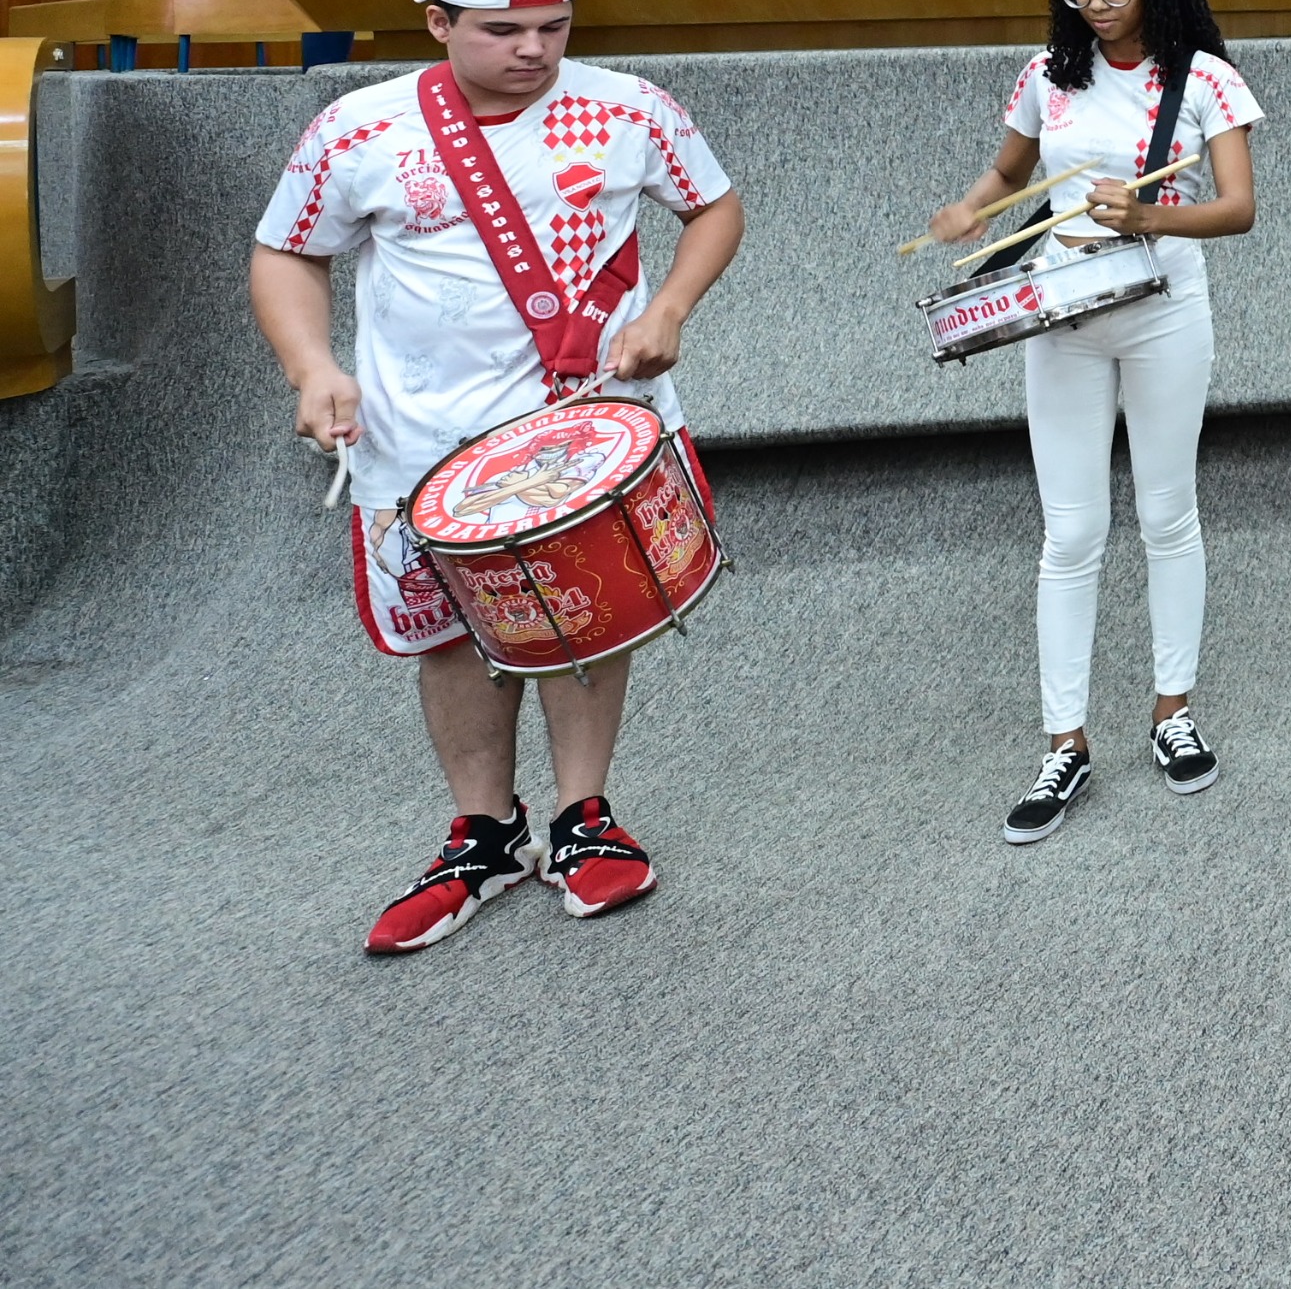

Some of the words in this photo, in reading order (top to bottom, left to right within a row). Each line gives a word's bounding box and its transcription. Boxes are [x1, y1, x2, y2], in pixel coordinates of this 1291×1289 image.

[404, 209, 470, 234] squadrão
[416, 460, 470, 517] torcida
[437, 510, 567, 540] BATERIA
[555, 844, 633, 863] Champion
[404, 863, 488, 895] Champion
